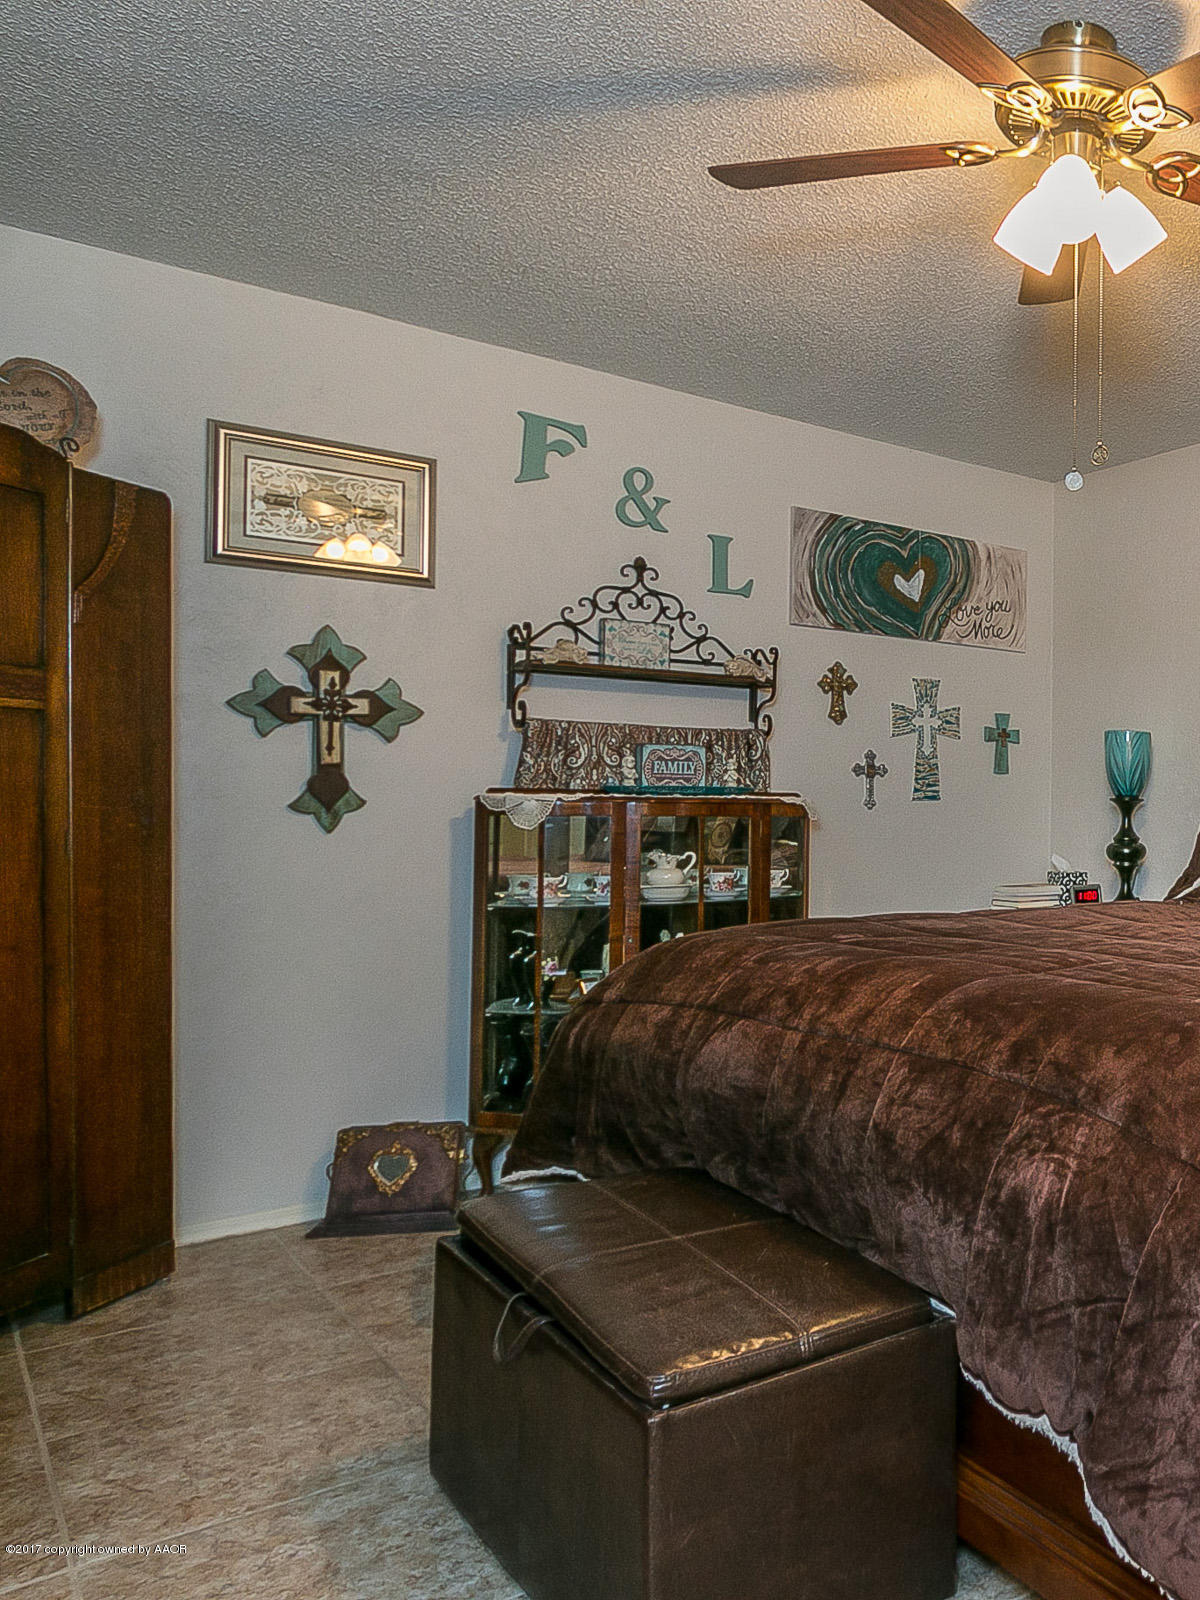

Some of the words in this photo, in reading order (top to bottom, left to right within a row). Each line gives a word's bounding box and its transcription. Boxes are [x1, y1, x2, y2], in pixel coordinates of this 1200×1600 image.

[514, 411, 587, 483] F
[615, 467, 671, 533] &
[707, 534, 754, 598] L
[938, 602, 983, 628] Love
[985, 600, 1012, 623] you
[956, 619, 1014, 640] More
[653, 760, 697, 774] FAMILY
